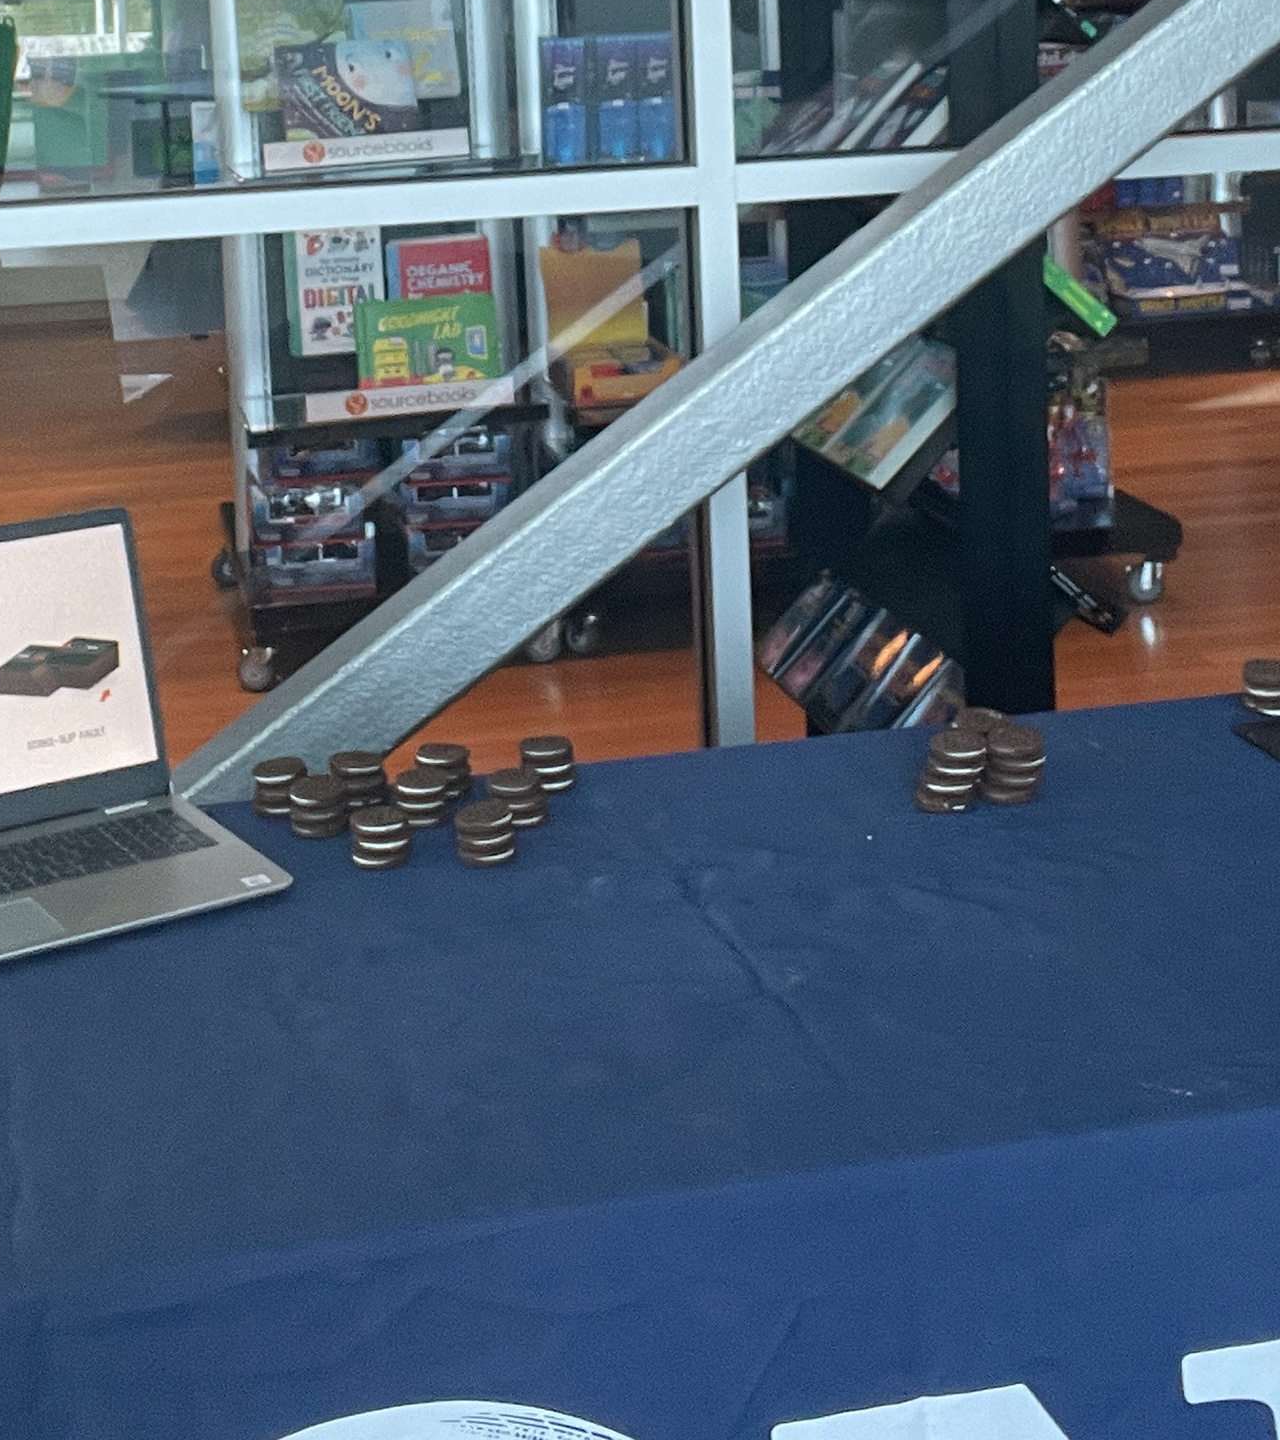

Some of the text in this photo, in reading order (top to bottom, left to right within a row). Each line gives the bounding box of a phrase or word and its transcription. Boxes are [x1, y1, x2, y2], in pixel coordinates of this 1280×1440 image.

[312, 65, 382, 132] MOON'S
[305, 263, 374, 277] DICTIONARY
[370, 386, 477, 410] sourcebooks
